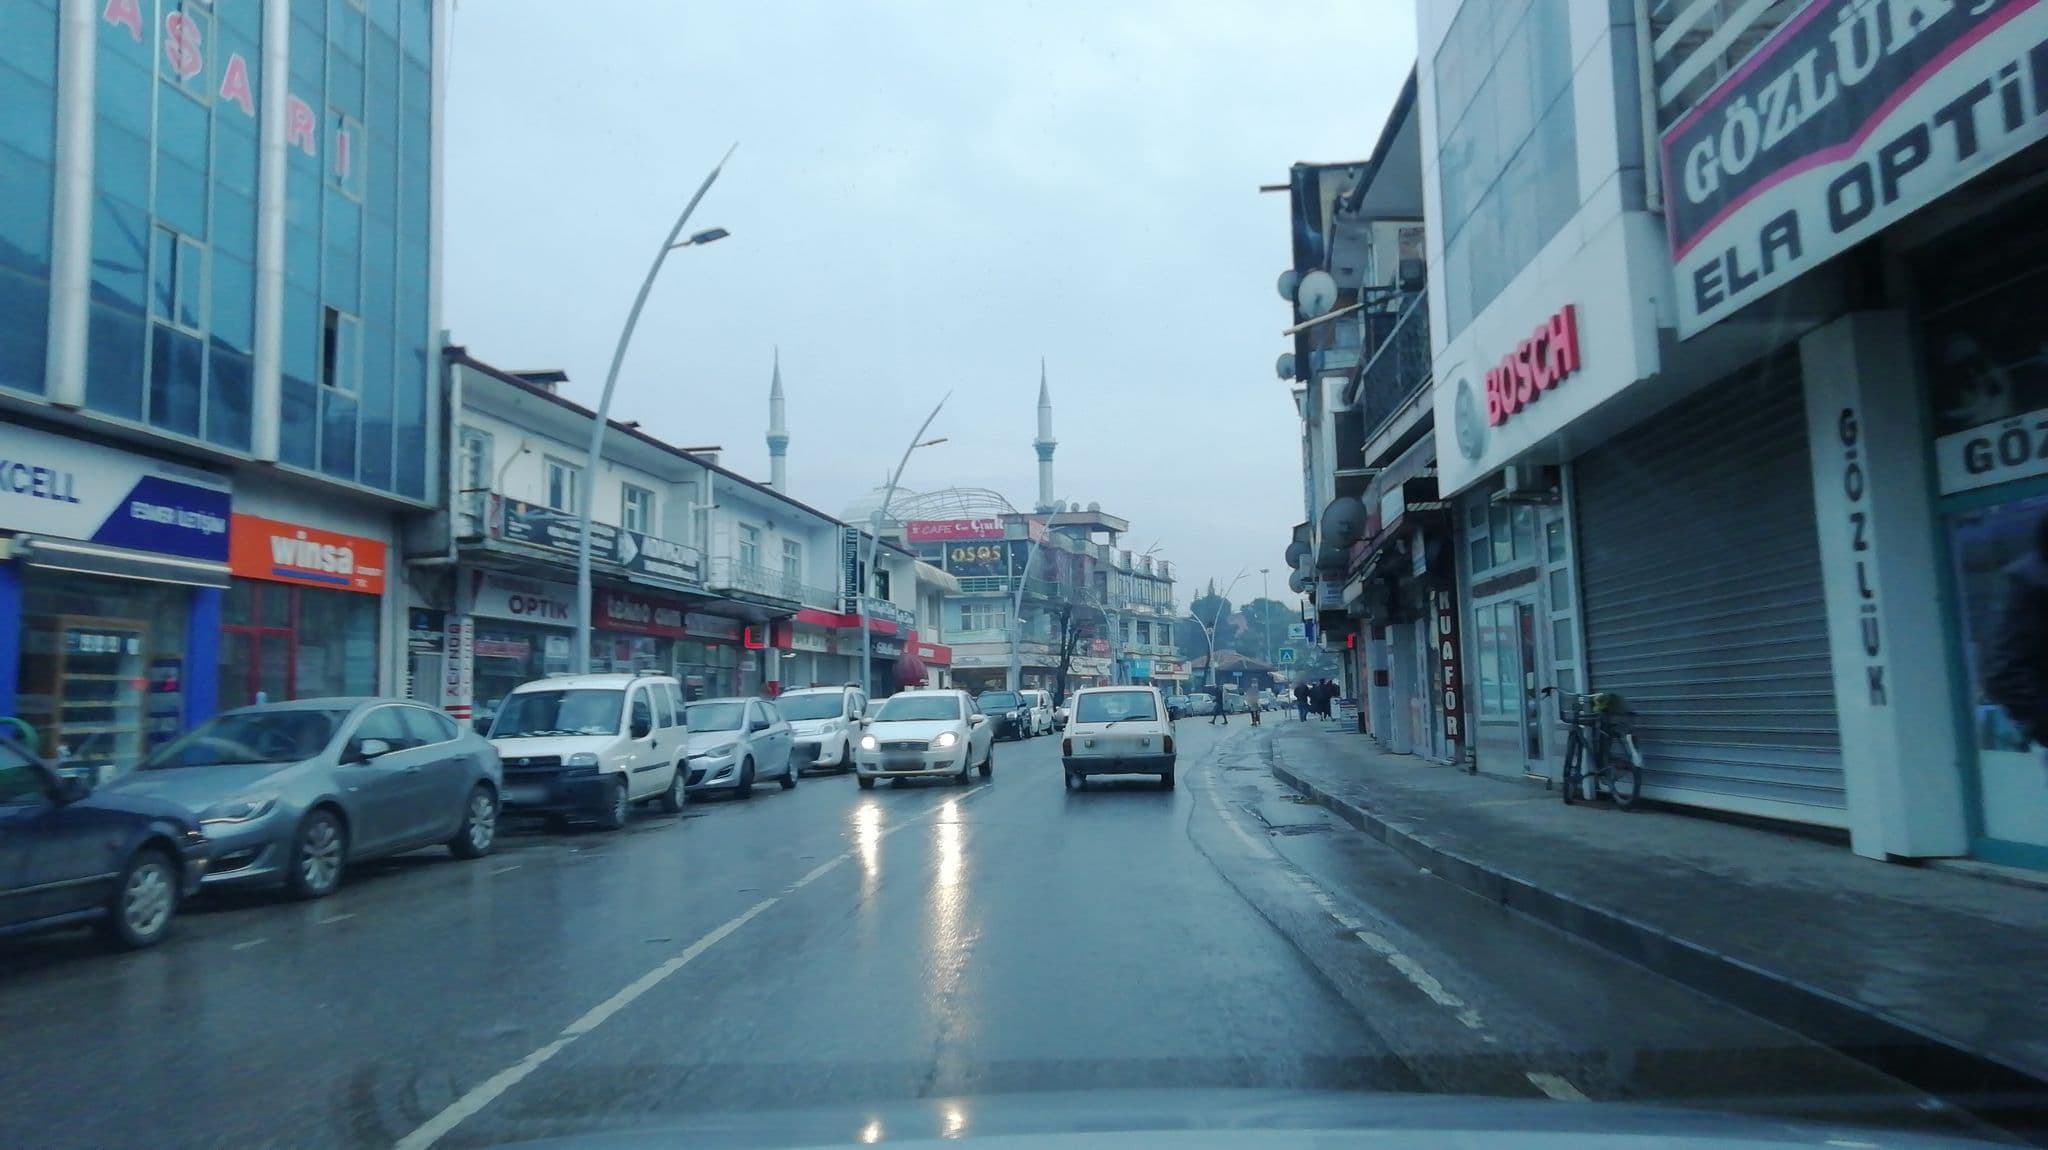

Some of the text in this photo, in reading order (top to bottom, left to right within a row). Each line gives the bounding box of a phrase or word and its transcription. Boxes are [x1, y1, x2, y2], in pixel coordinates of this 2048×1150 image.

[1693, 208, 1803, 315] ELA
[1485, 304, 1581, 428] BOSCH
[270, 530, 353, 575] winsa
[1838, 407, 1888, 707] GÖZLÜK
[1438, 590, 1458, 736] KUAFÖR
